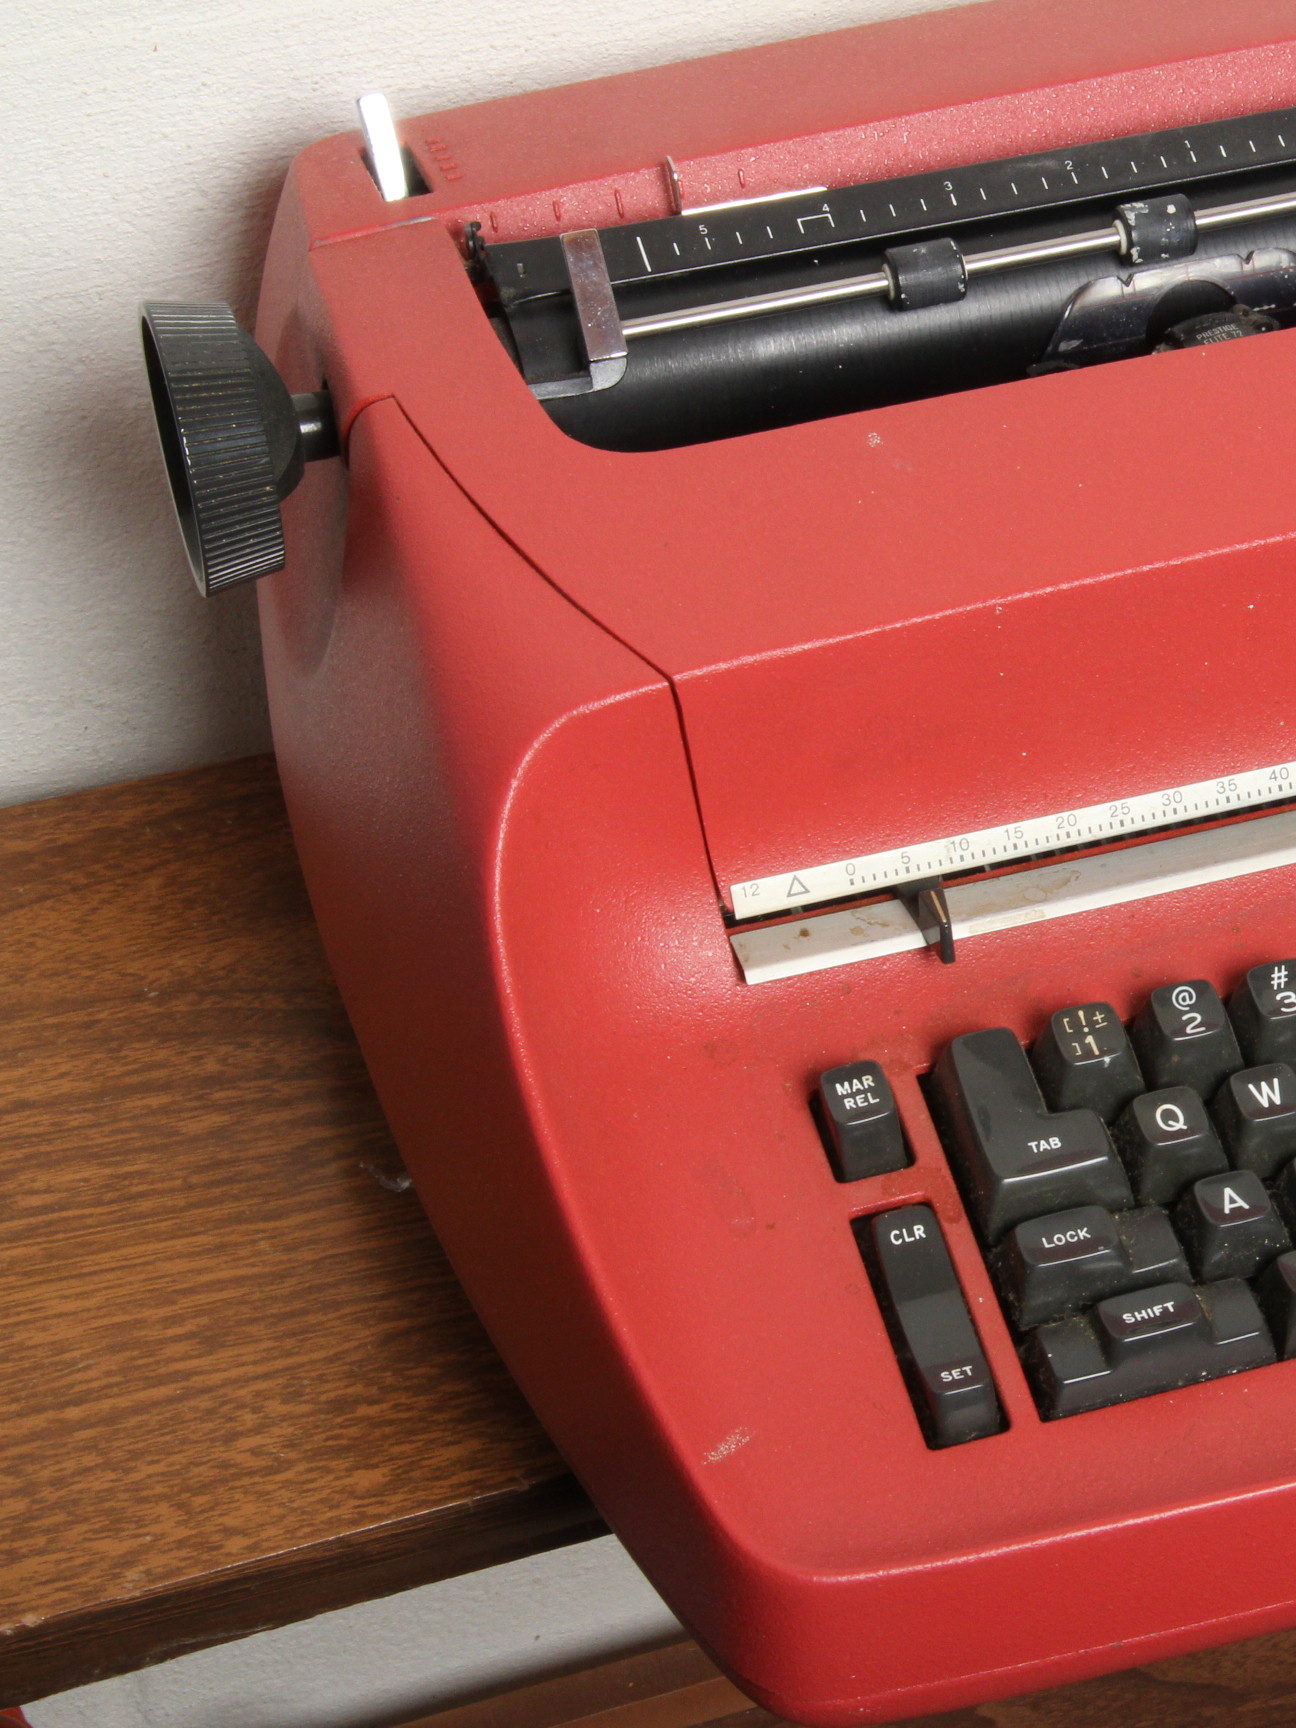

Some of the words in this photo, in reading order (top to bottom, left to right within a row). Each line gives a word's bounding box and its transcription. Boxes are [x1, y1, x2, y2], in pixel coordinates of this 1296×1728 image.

[698, 224, 708, 235] 5
[822, 203, 830, 212] 4
[943, 180, 953, 191] 3
[1064, 160, 1073, 171] 2
[741, 882, 761, 899] 12
[845, 862, 856, 876] 0
[900, 851, 911, 865] 5
[950, 838, 970, 851] 10
[1004, 826, 1024, 841] 15
[1056, 813, 1077, 829] 20
[1109, 801, 1131, 818] 25
[1161, 790, 1183, 807] 30
[1216, 778, 1237, 794] 35
[1269, 767, 1290, 782] 40
[1270, 964, 1289, 991] #
[1171, 985, 1197, 1011] @
[1181, 1012, 1206, 1034] 2
[1084, 1034, 1100, 1056] 1
[835, 1075, 875, 1096] MAR
[1247, 1077, 1281, 1108] W
[843, 1092, 880, 1110] REL
[1155, 1103, 1188, 1132] Q
[1027, 1136, 1062, 1153] TAB
[1223, 1186, 1250, 1214] A
[890, 1224, 927, 1245] CLR
[1041, 1227, 1091, 1248] LOCK
[1122, 1301, 1175, 1324] SHIFT
[940, 1365, 973, 1382] SET
